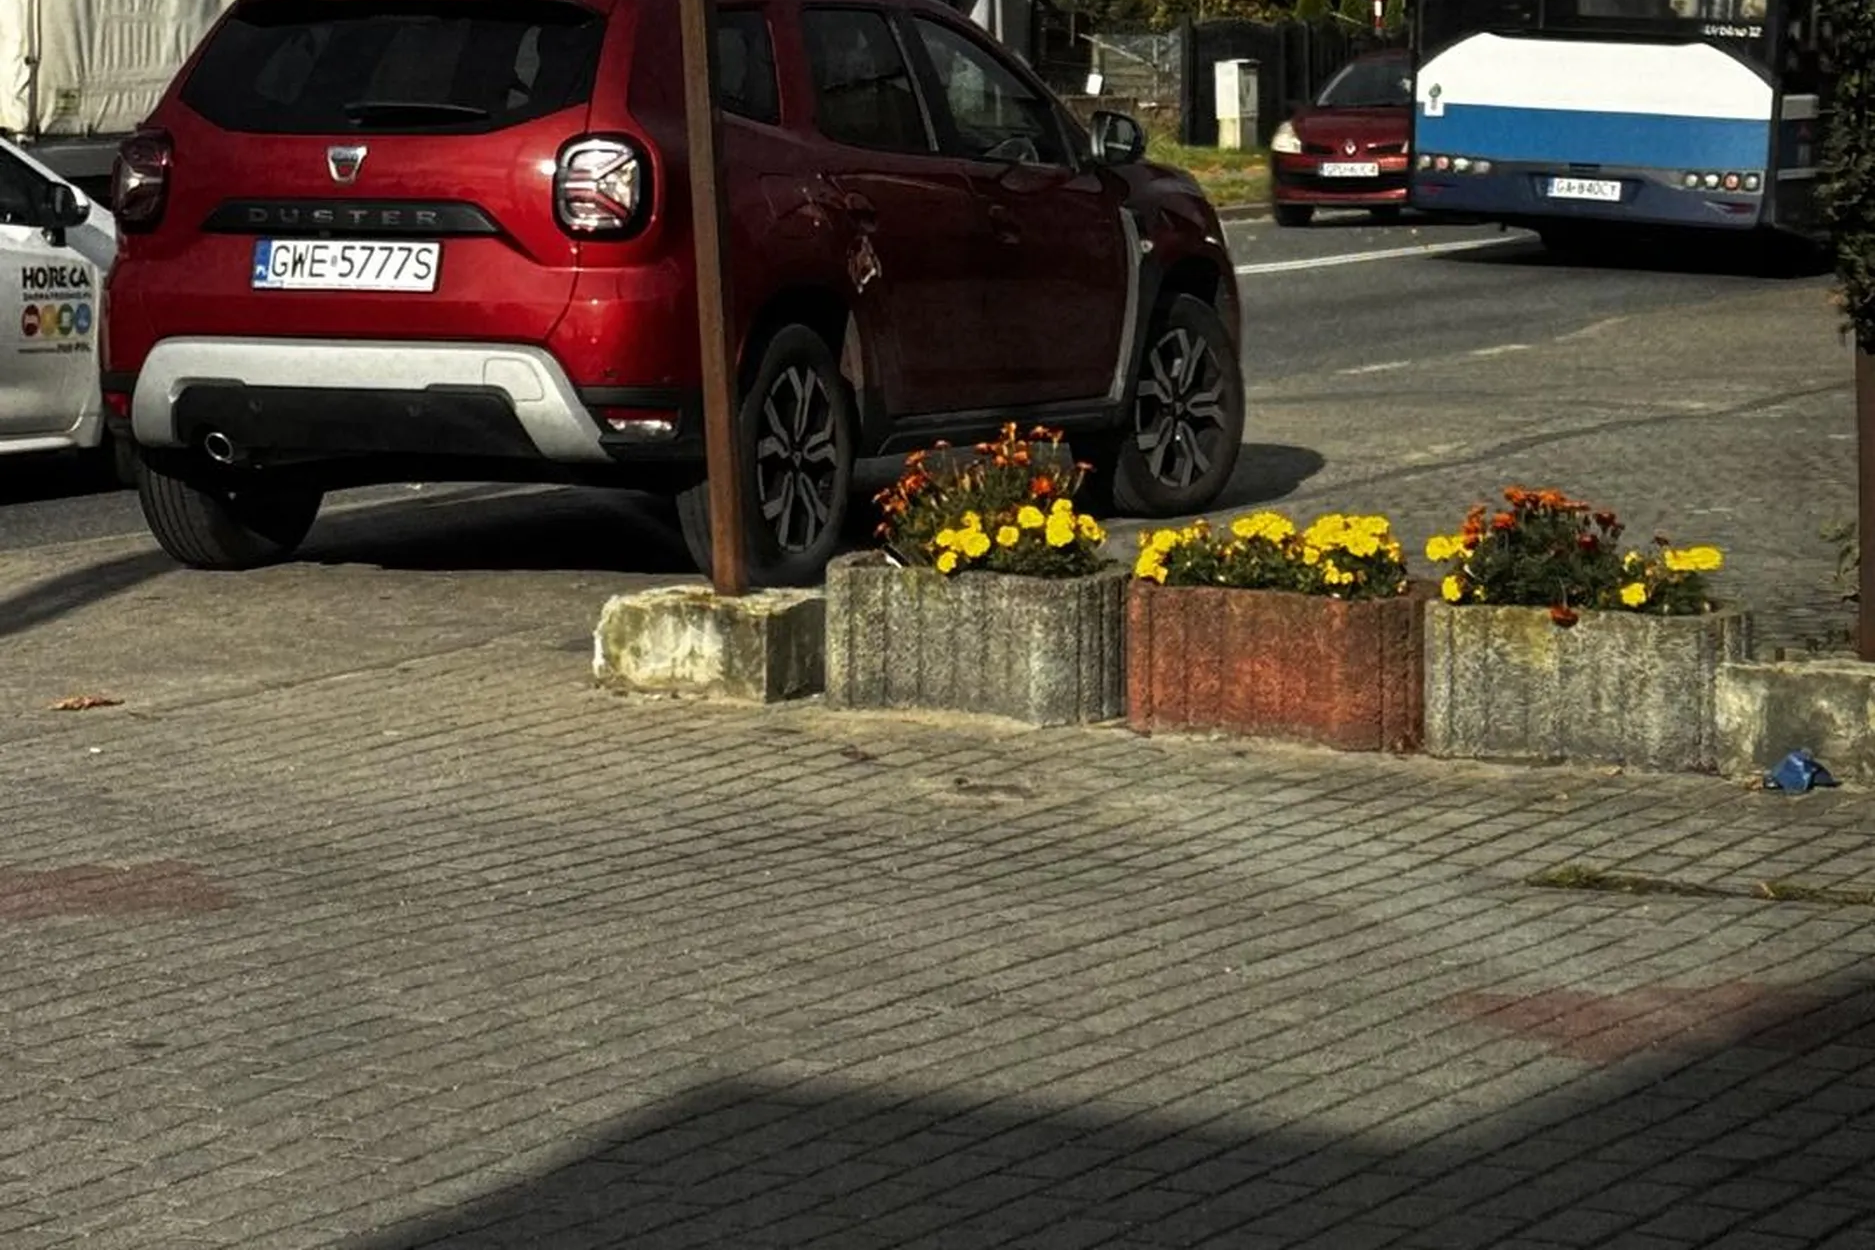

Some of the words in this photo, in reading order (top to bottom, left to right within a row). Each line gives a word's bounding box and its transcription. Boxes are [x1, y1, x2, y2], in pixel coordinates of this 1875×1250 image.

[249, 207, 437, 226] DUSTER
[272, 244, 330, 278] GWE
[337, 245, 434, 281] 5777S
[21, 265, 91, 289] HORECA
